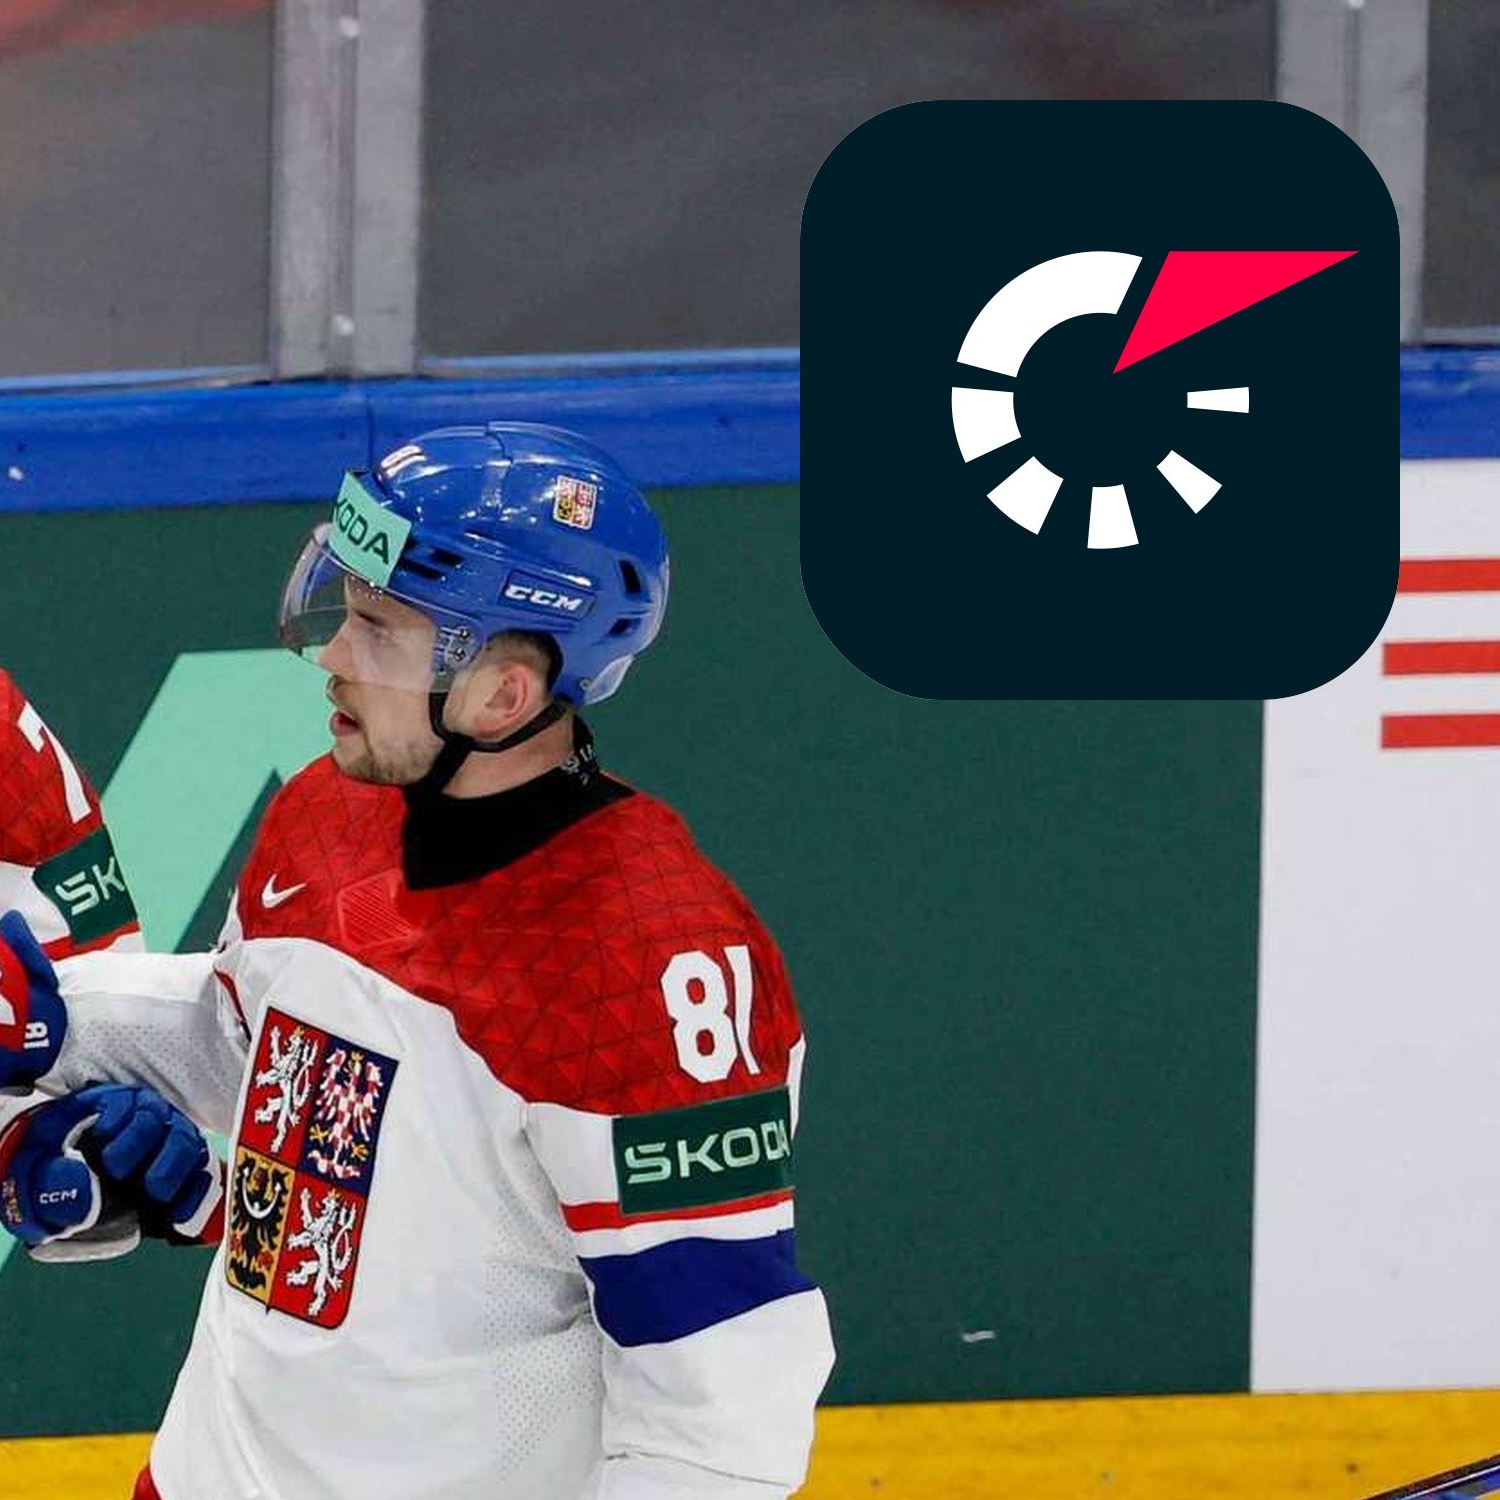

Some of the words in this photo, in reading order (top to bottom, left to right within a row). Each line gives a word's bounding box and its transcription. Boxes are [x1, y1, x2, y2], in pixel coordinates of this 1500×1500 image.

[504, 584, 582, 612] CCM
[660, 945, 761, 1083] 81
[39, 1190, 78, 1204] CCM
